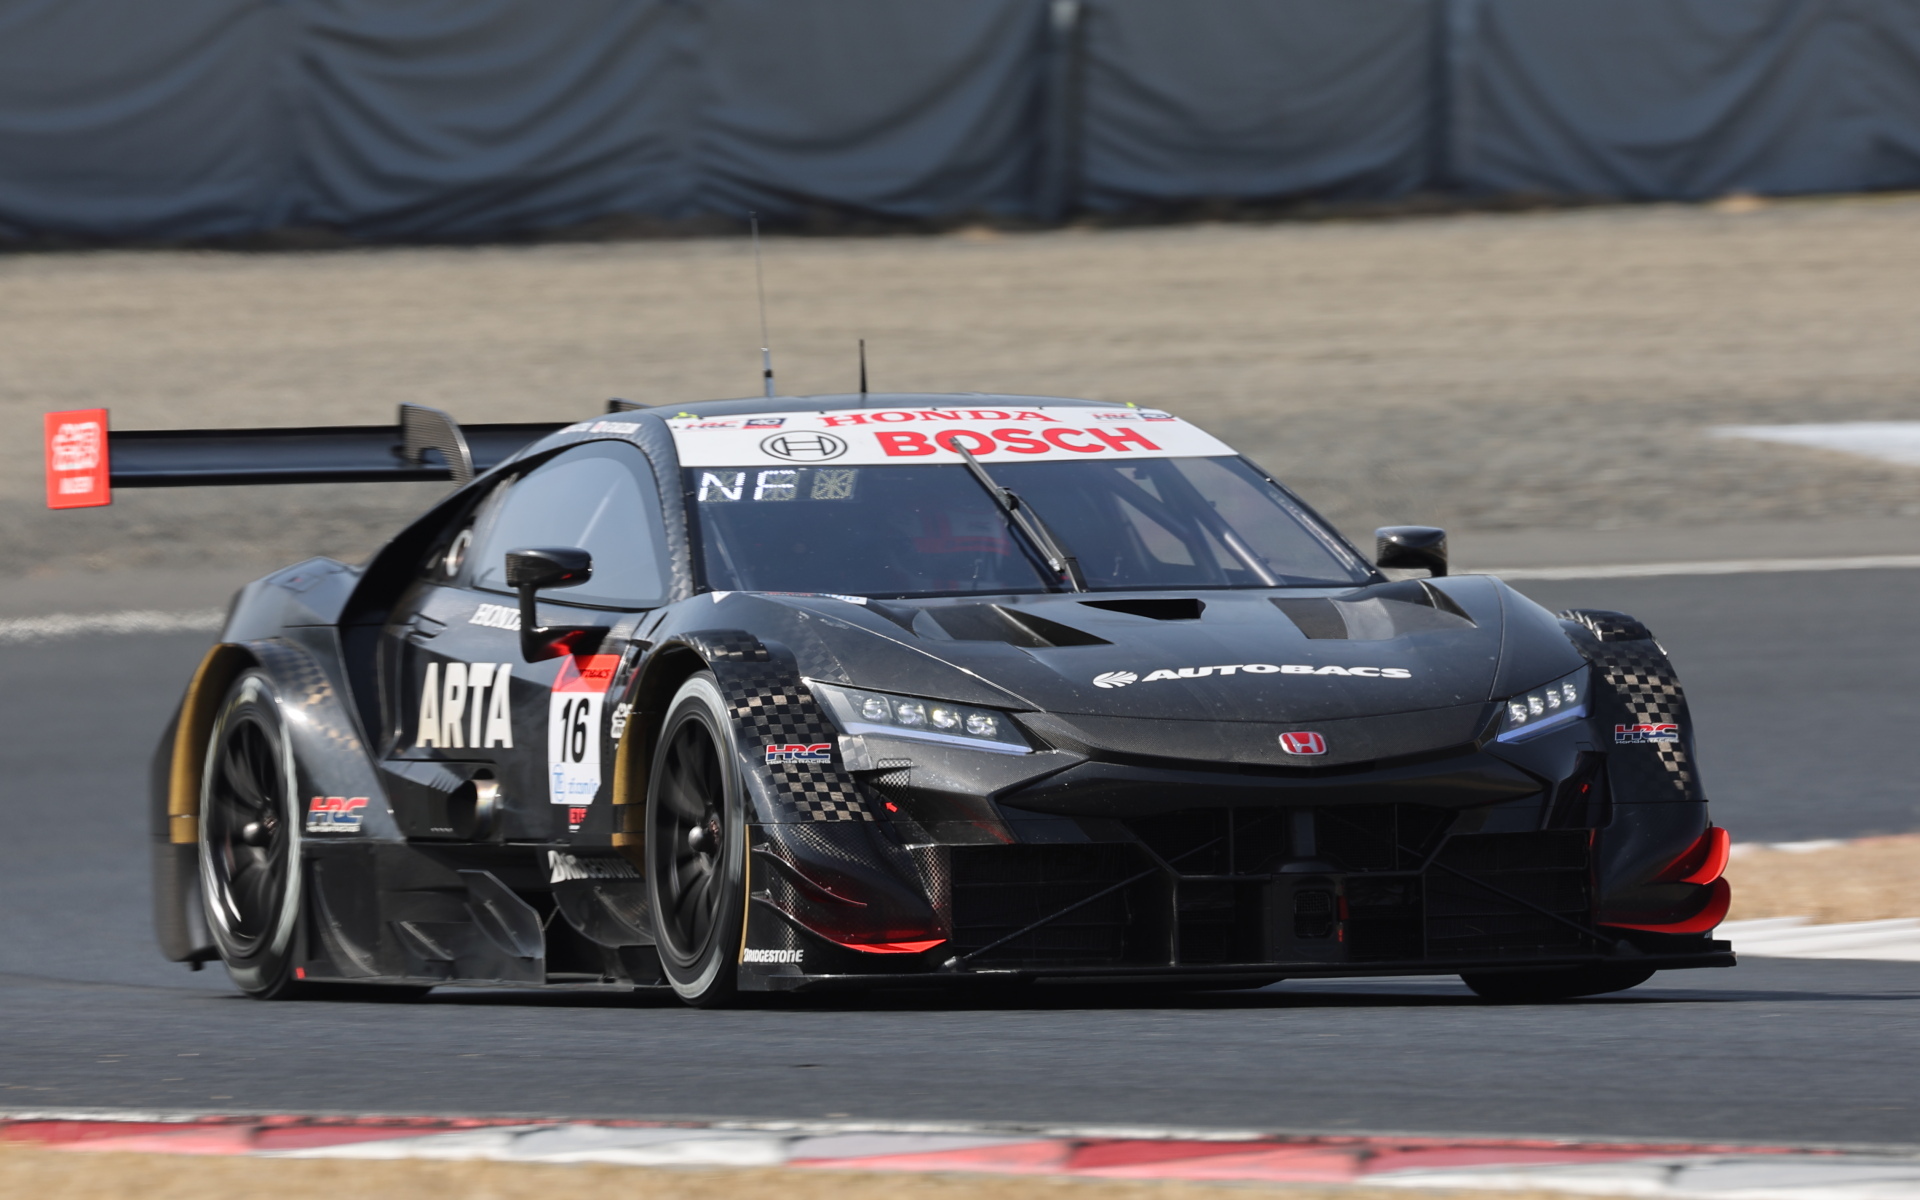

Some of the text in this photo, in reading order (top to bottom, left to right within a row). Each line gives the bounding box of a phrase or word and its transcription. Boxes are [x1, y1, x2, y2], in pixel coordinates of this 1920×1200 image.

[817, 408, 1063, 427] HONDA
[874, 427, 1163, 457] BOSCH
[1142, 663, 1412, 682] AUTOBACS
[416, 662, 514, 748] ARTA
[560, 697, 590, 763] 16
[1615, 724, 1678, 740] HRC
[766, 743, 831, 760] HRC
[306, 796, 370, 825] HRC
[743, 948, 804, 963] BRIDGESTONE
